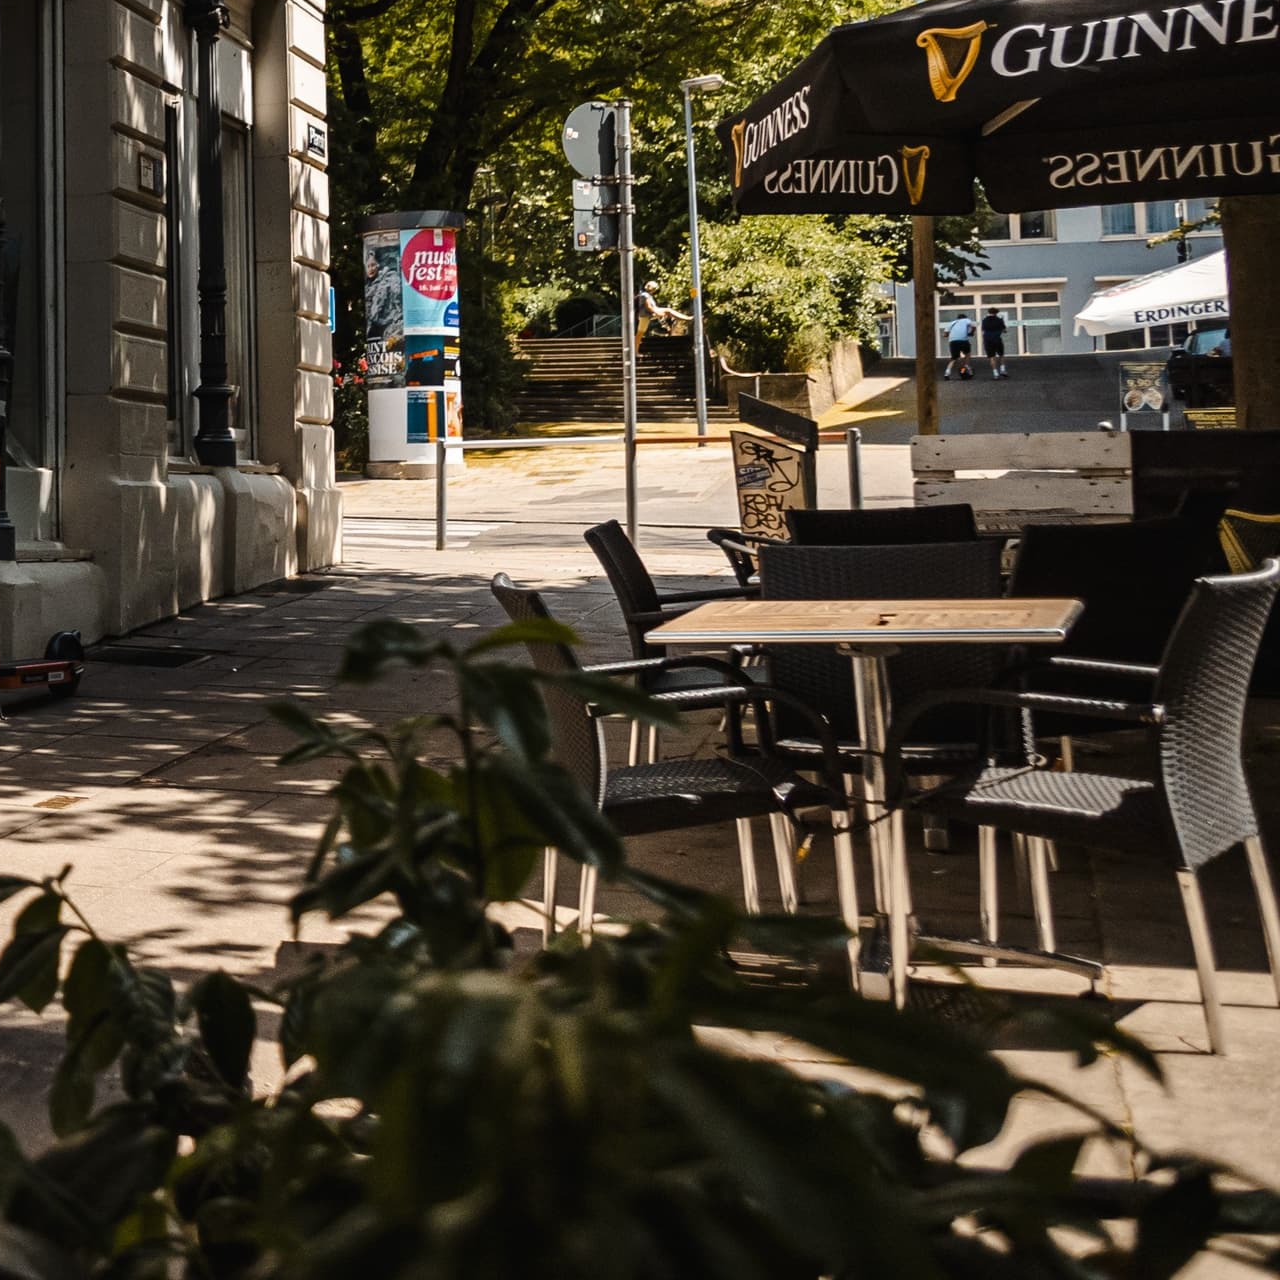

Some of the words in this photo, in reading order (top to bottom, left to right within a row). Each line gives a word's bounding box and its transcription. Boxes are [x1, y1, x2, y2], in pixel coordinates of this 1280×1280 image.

[743, 85, 811, 169] GUINNESS
[407, 263, 443, 286] fest
[1134, 300, 1228, 324] ERDINGER
